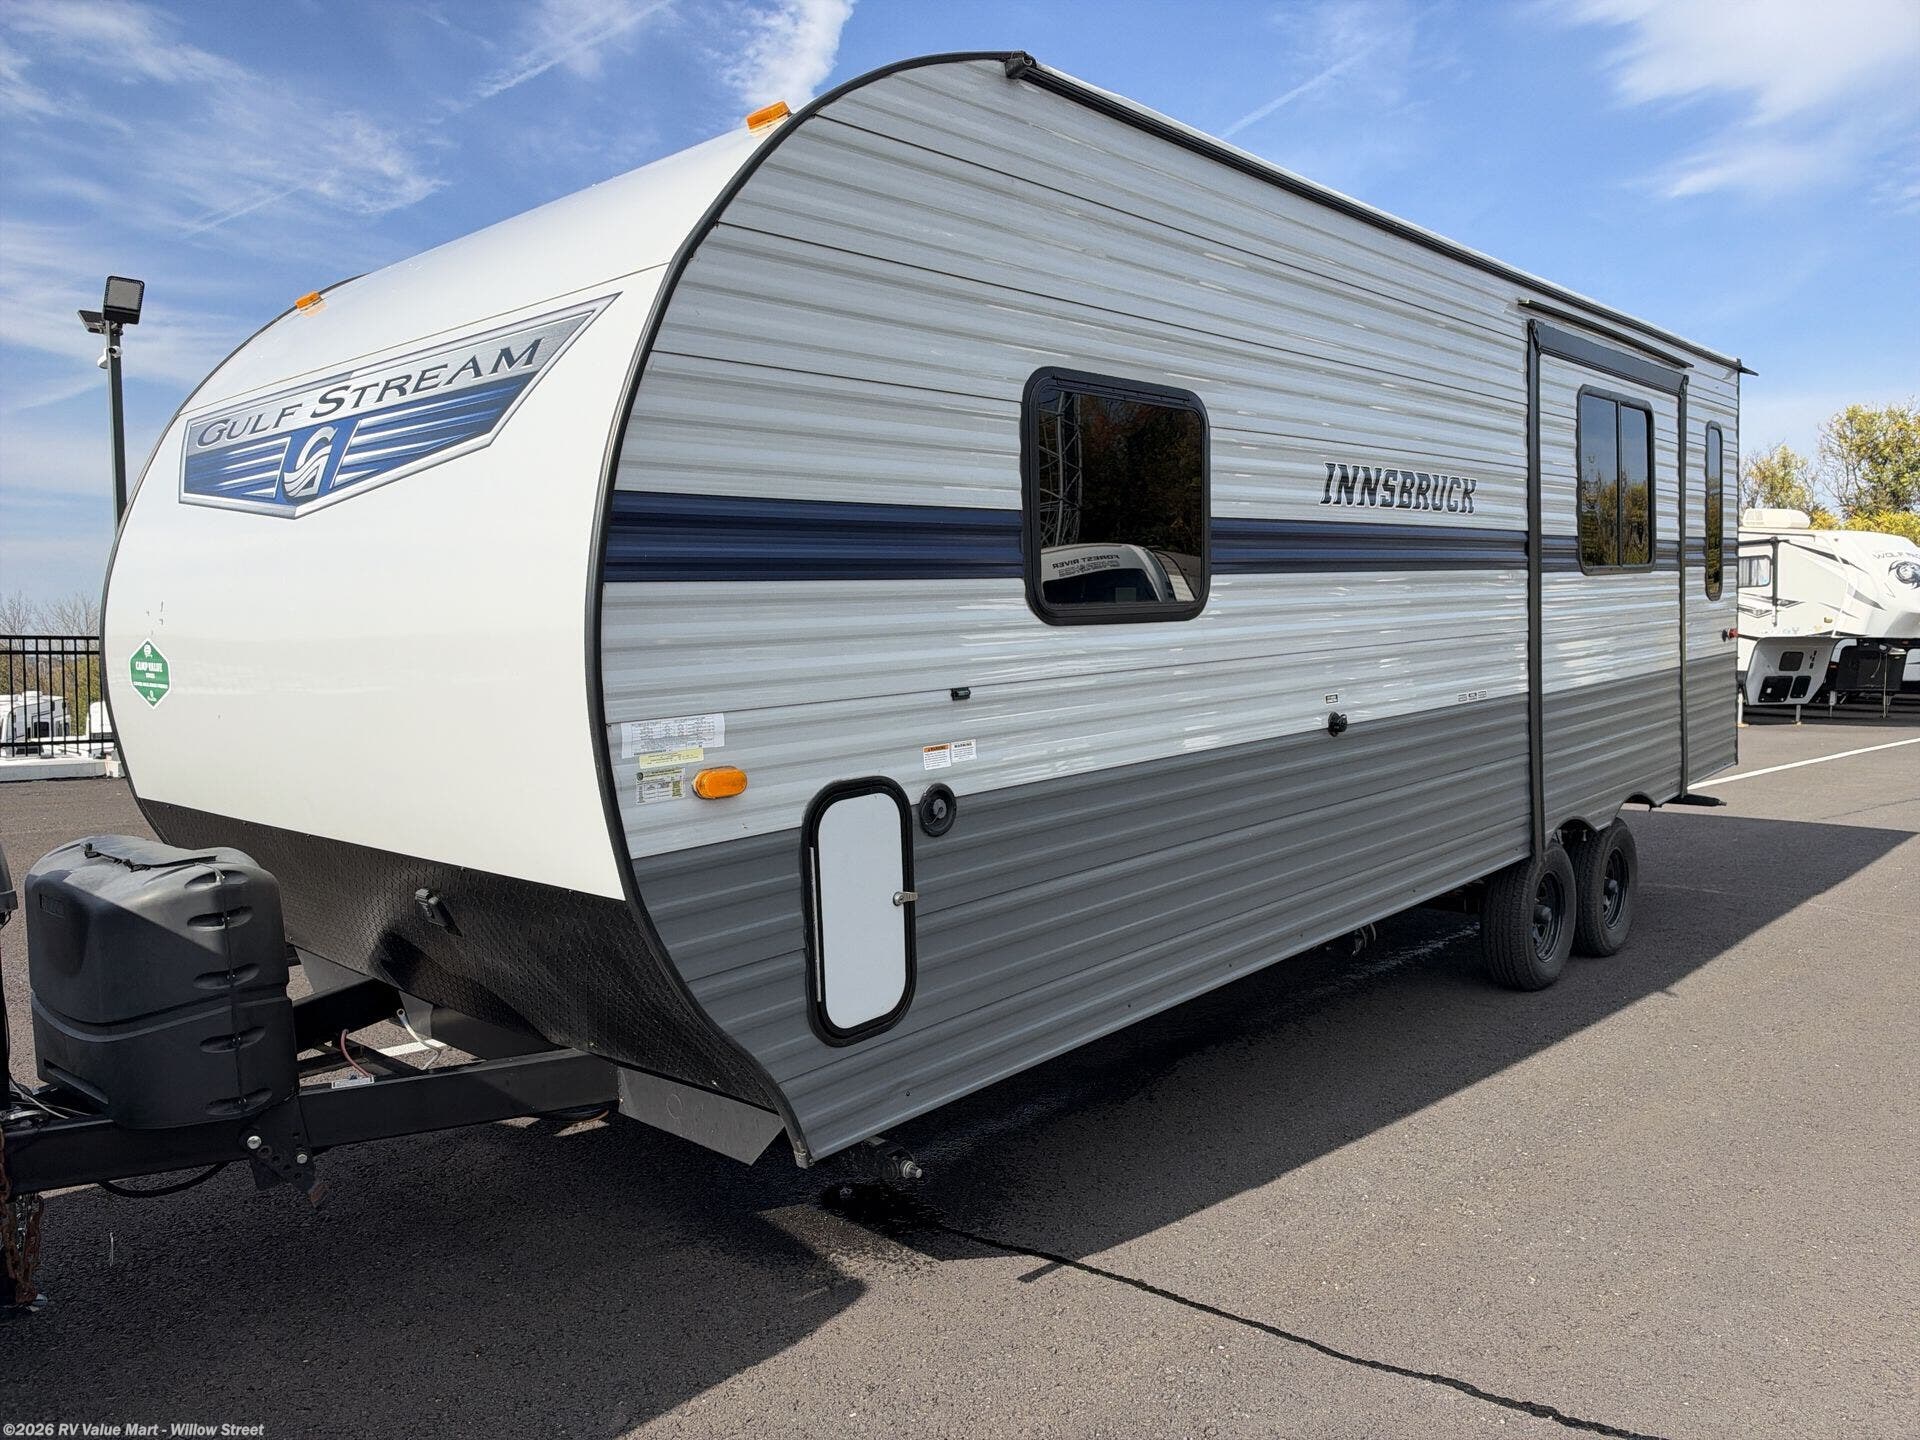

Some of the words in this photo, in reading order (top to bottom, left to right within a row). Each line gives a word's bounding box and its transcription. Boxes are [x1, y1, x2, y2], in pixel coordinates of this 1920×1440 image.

[197, 403, 302, 448] GULF
[310, 337, 545, 419] STREAM
[1319, 461, 1478, 514] INNSBRUCK
